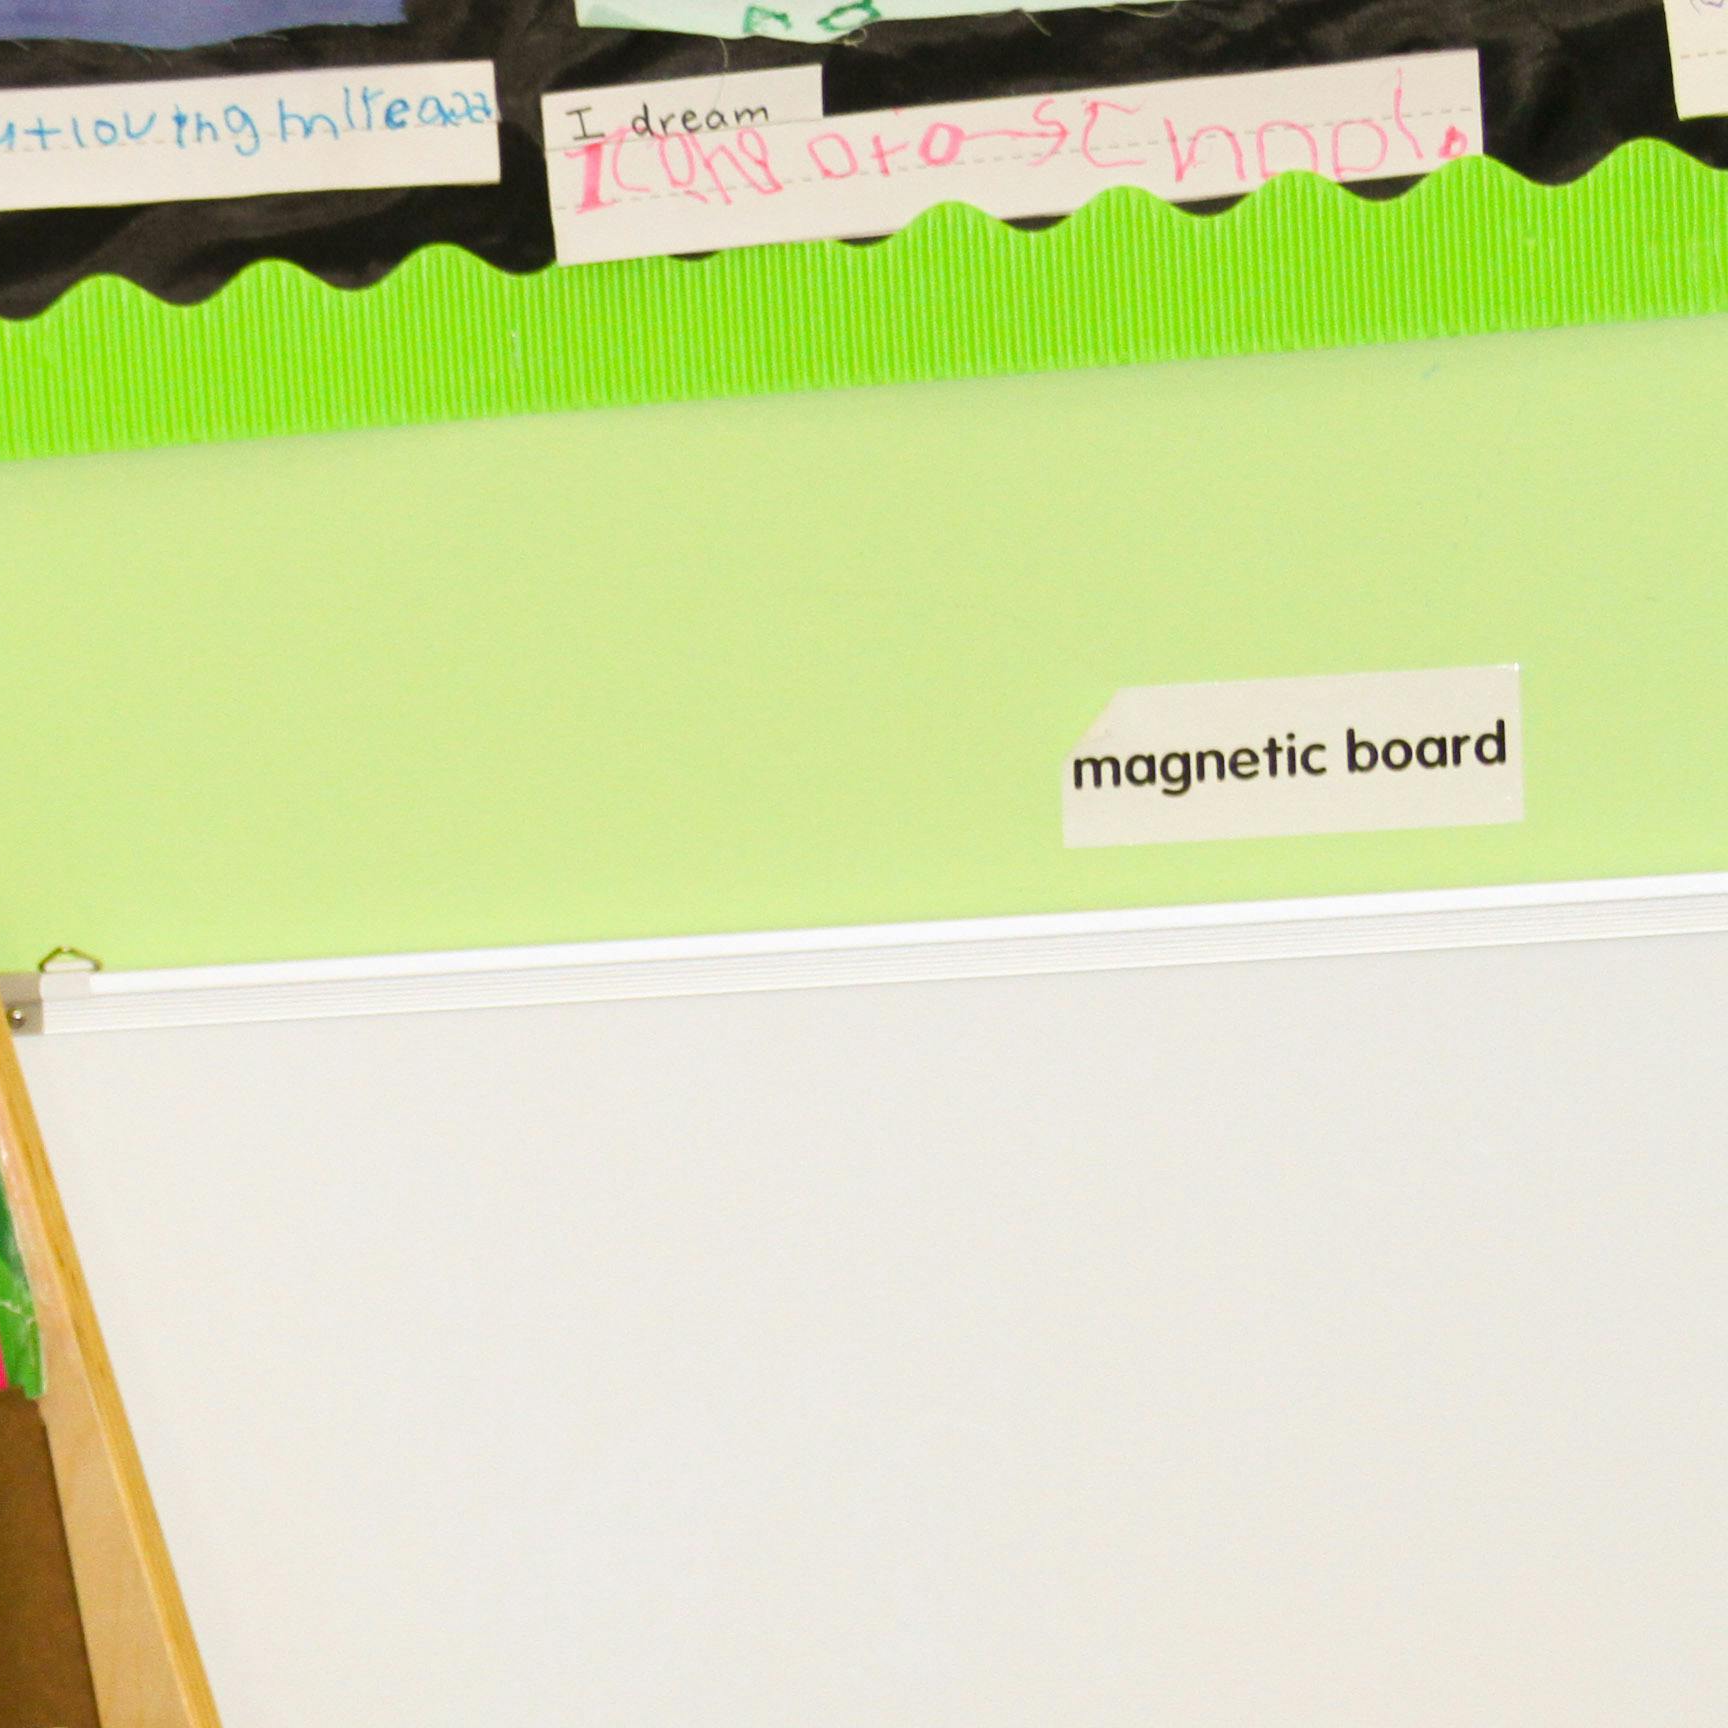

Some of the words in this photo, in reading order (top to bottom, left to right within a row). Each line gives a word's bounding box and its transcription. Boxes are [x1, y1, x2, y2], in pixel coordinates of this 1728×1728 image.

[565, 106, 605, 141] I
[631, 103, 769, 137] dream
[1072, 732, 1327, 797] magnetic
[1344, 719, 1508, 775] board
